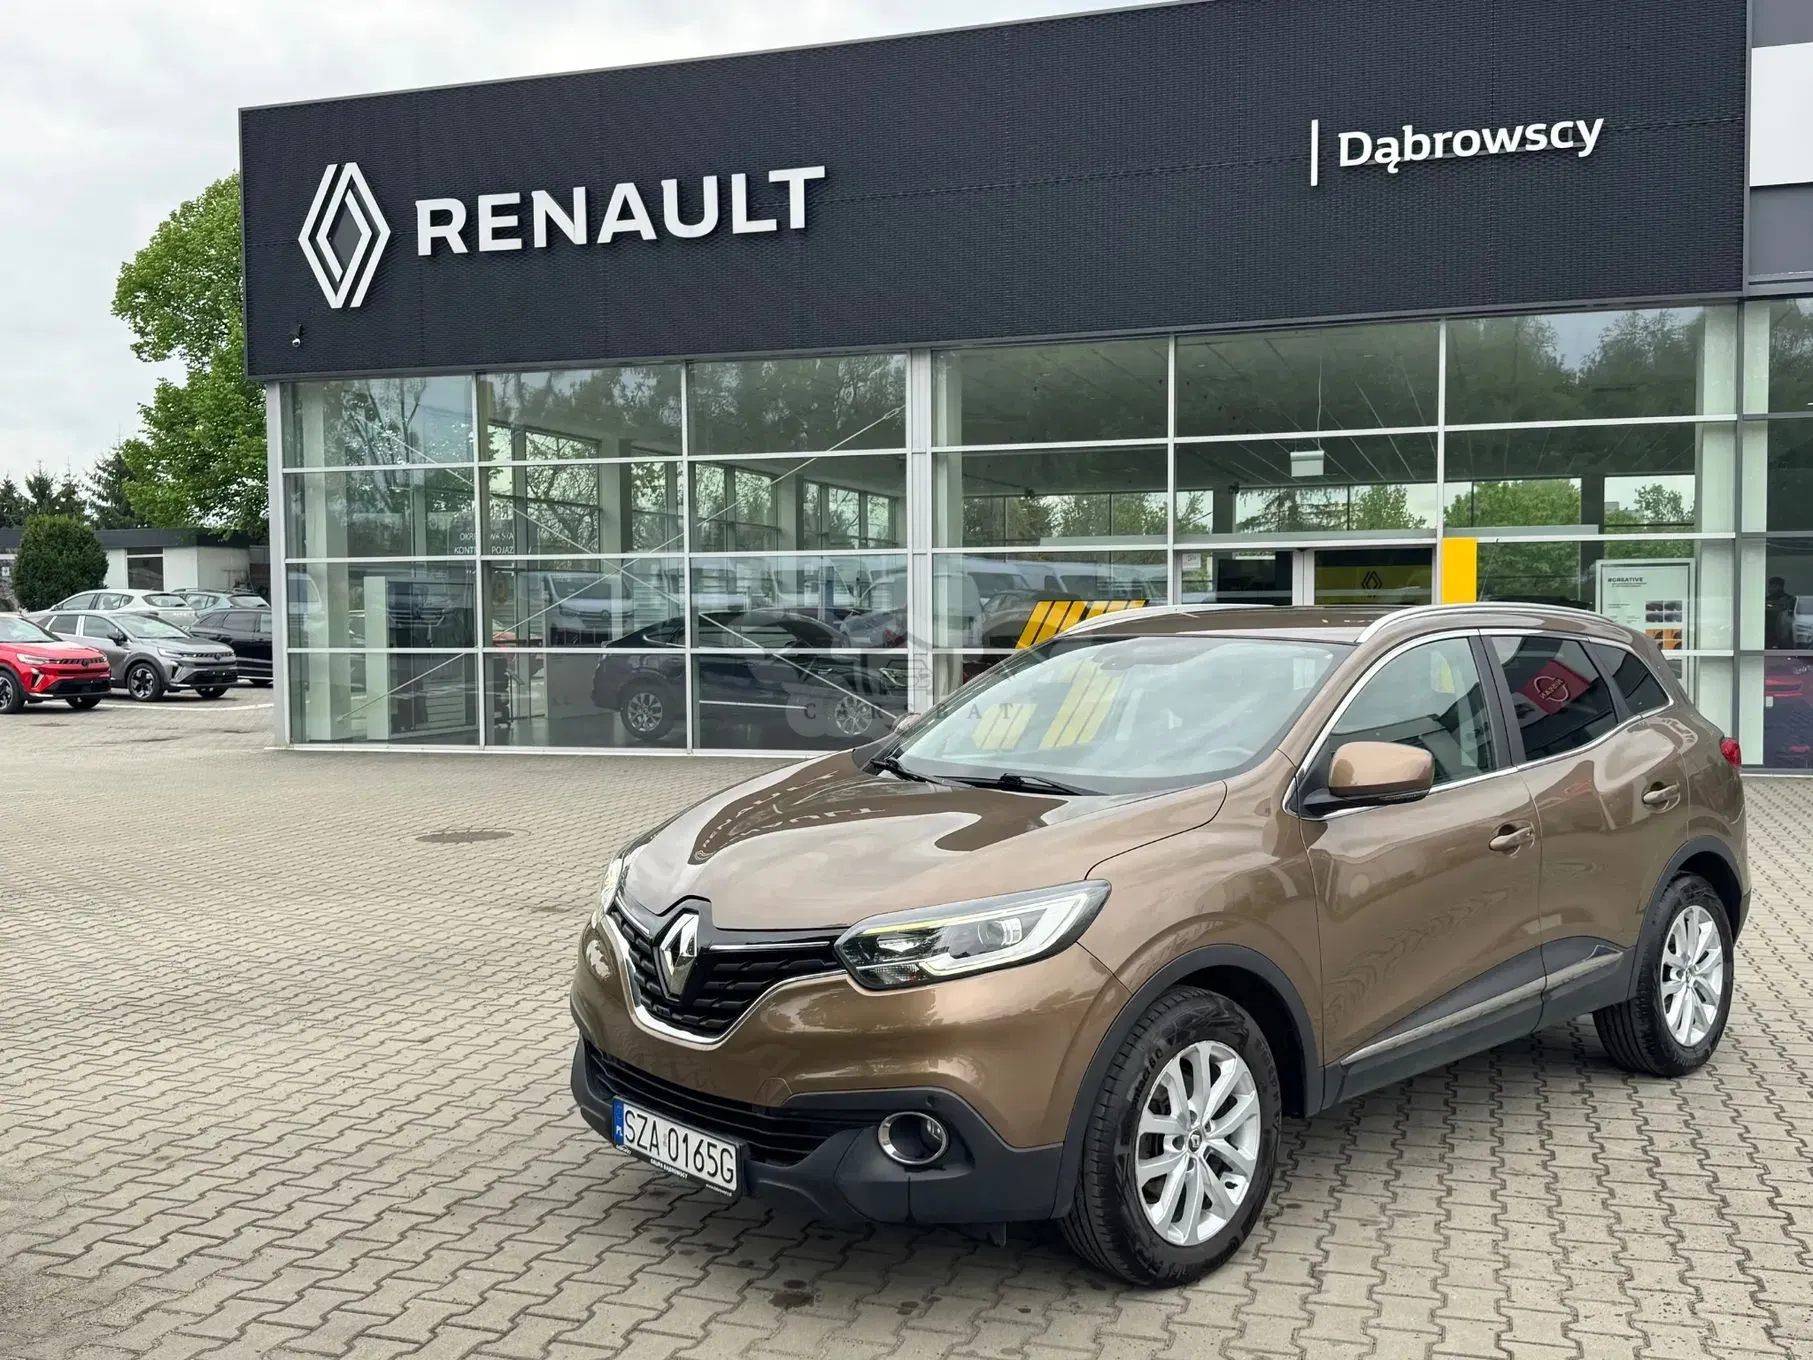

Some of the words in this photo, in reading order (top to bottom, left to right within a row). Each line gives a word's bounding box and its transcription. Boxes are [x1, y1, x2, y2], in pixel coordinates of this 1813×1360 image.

[1338, 118, 1605, 174] Dąbrowscy
[416, 165, 826, 257] RENAULT
[616, 1125, 623, 1137] PL
[625, 1110, 660, 1156] SZA
[668, 1127, 734, 1184] 0165G
